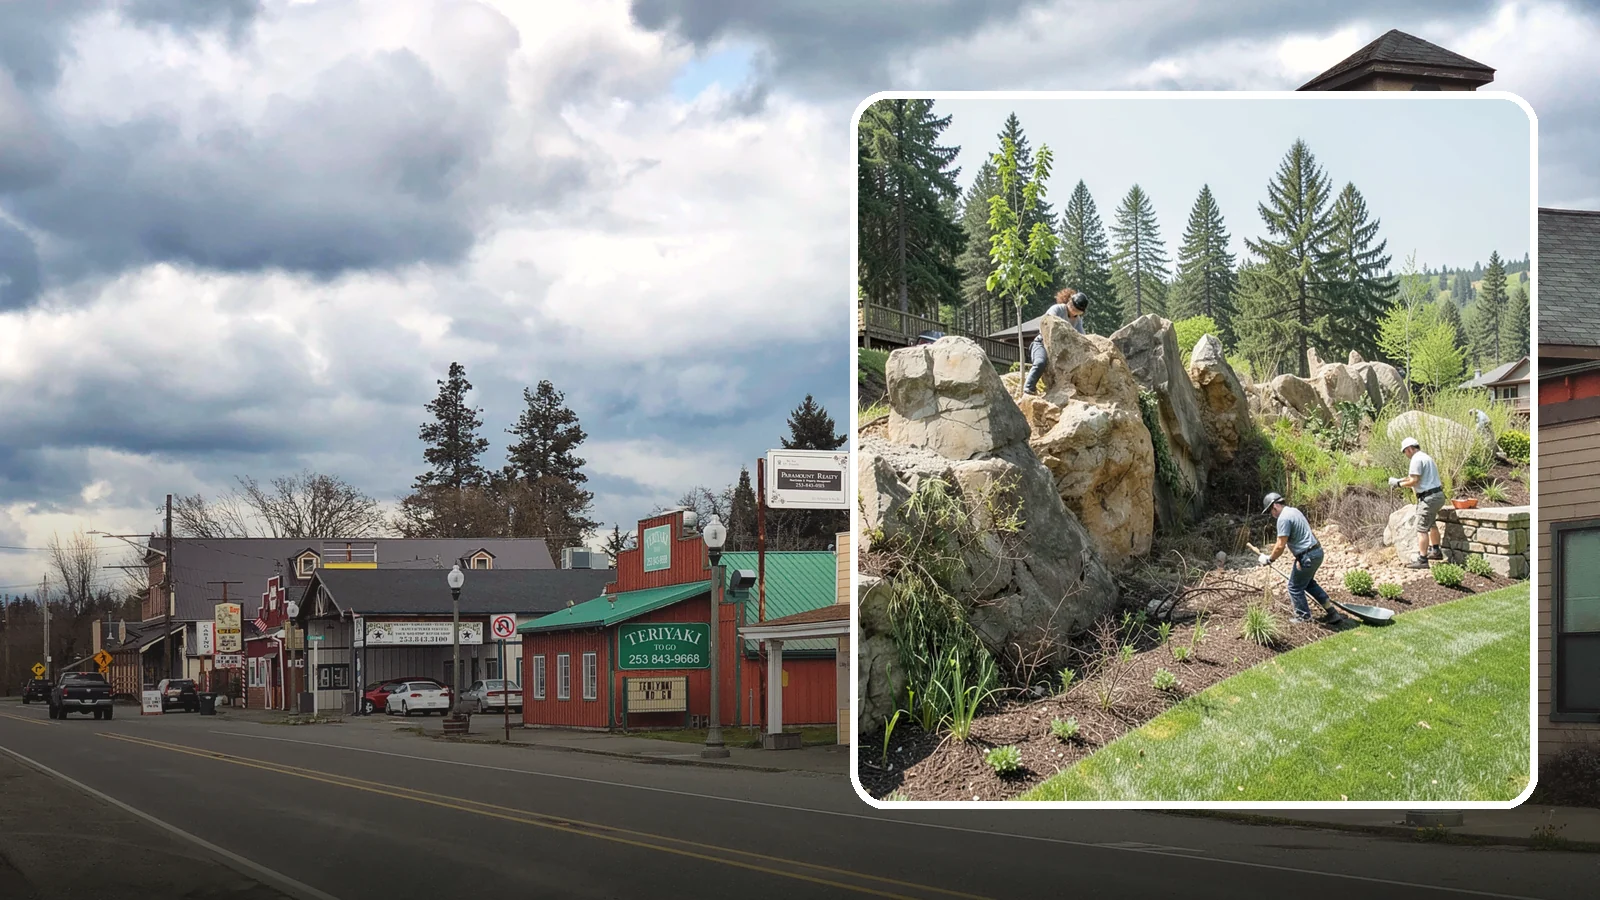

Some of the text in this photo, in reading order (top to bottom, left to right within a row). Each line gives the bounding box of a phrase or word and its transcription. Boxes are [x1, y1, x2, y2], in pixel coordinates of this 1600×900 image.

[625, 627, 702, 646] TERIYAKI
[629, 653, 700, 665] 253 843-9668
